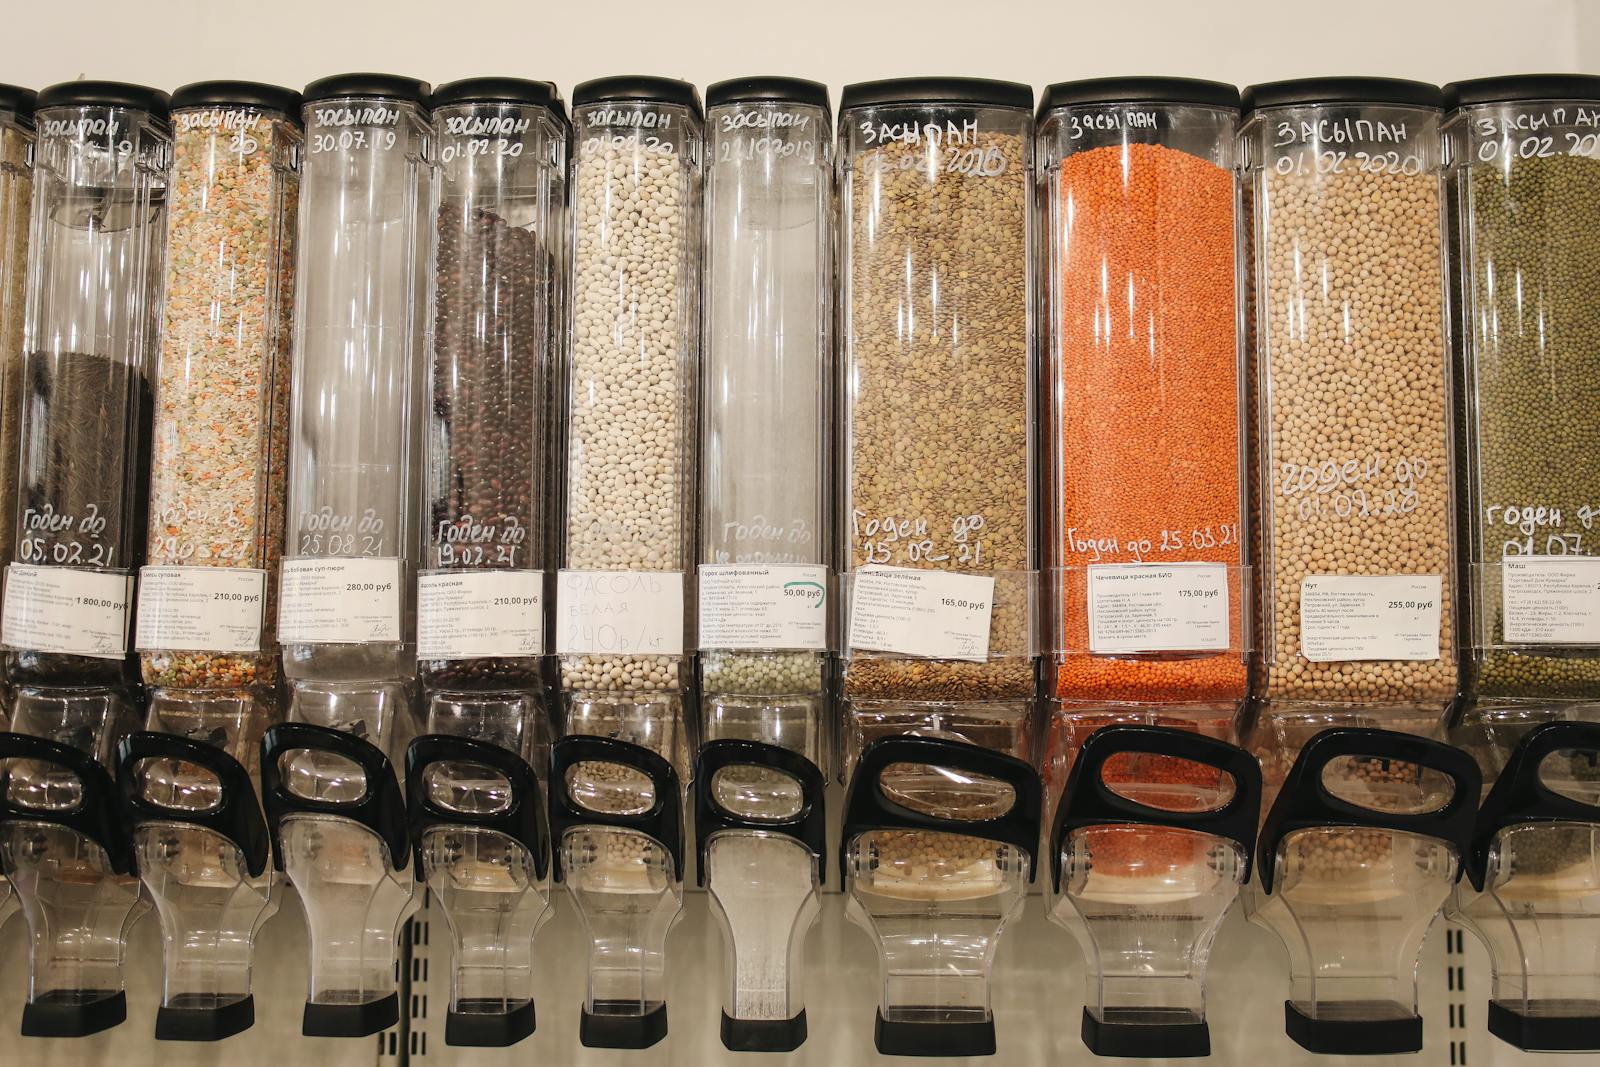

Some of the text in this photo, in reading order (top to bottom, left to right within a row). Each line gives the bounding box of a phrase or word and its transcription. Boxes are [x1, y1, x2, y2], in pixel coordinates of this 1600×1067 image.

[79, 504, 106, 534] до
[358, 508, 384, 534] до
[952, 514, 984, 542] до
[501, 516, 526, 544] до
[788, 519, 811, 544] до
[21, 538, 113, 566] 05.02.21
[1127, 539, 1151, 563] до
[376, 583, 392, 592] руб
[567, 574, 661, 598] ФАСОЛЬ
[807, 590, 820, 598] руб
[1204, 589, 1218, 598] руб
[83, 598, 111, 608] 800,00
[523, 596, 538, 605] руб
[569, 602, 628, 616] БЕЛАЯ
[942, 598, 985, 610] 165,00 руб
[1417, 601, 1433, 610] руб
